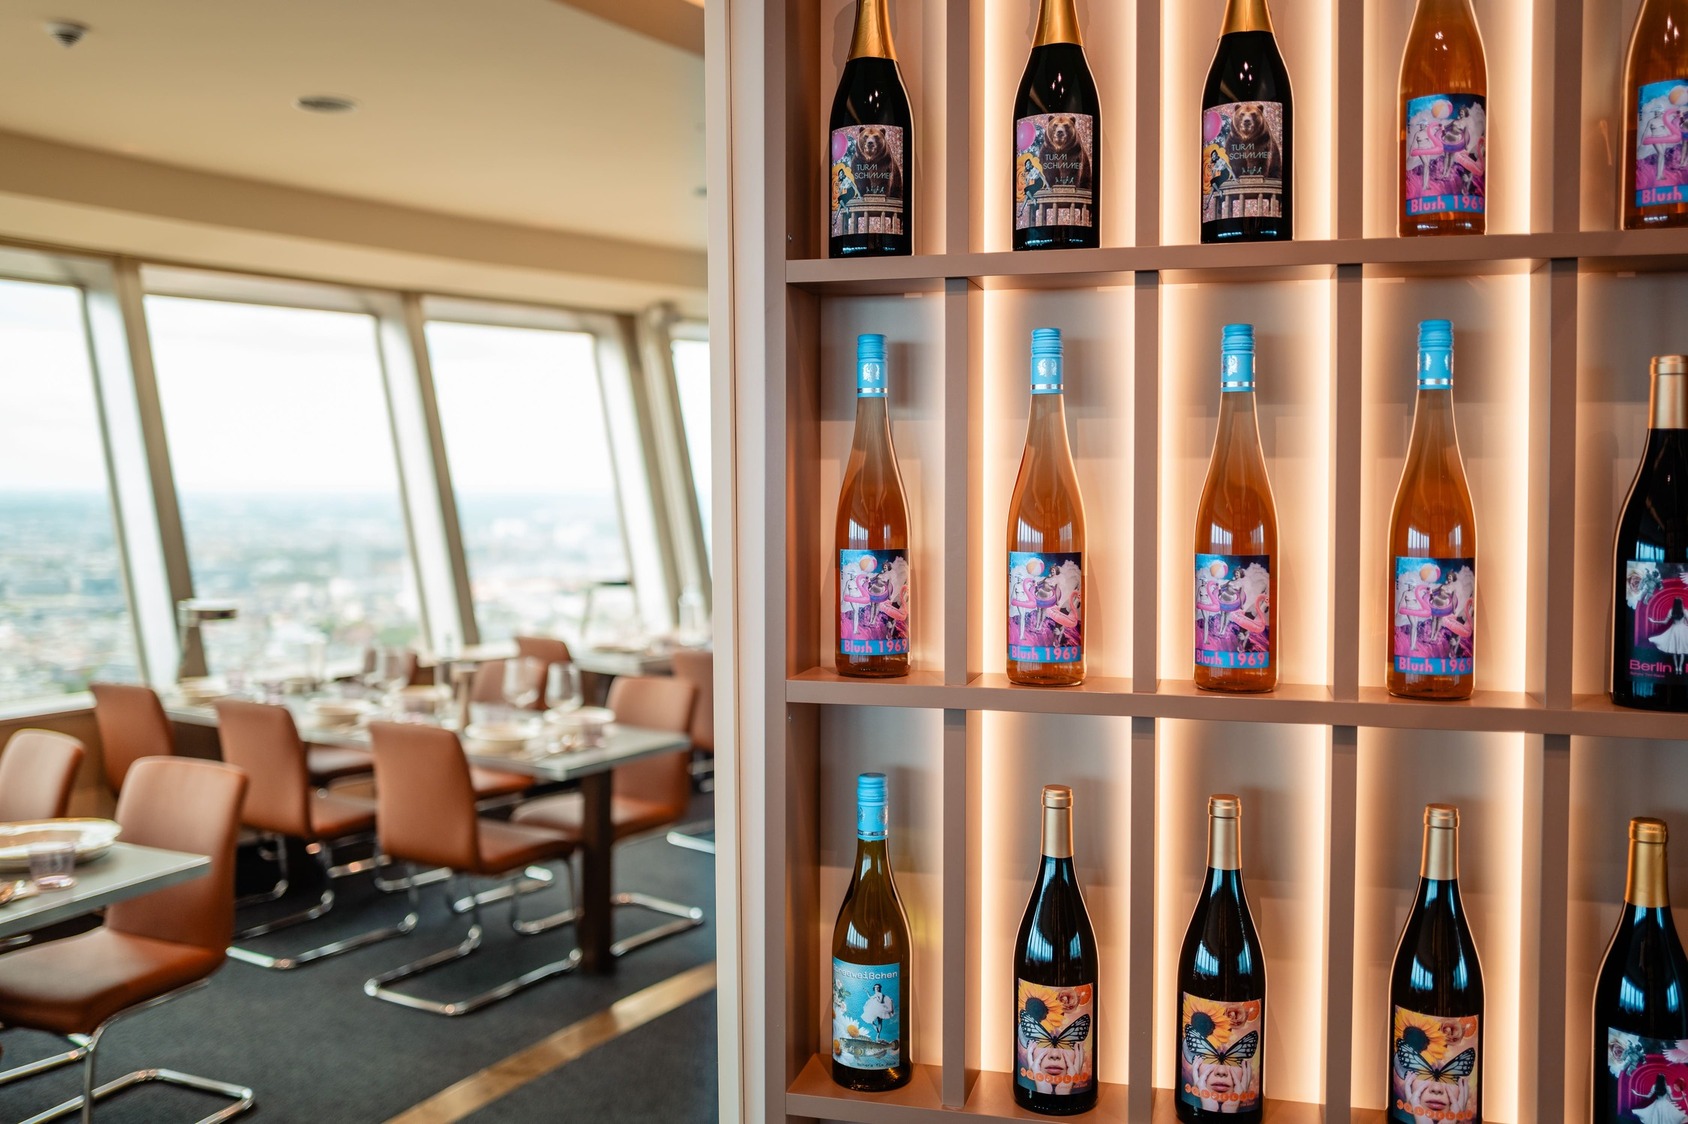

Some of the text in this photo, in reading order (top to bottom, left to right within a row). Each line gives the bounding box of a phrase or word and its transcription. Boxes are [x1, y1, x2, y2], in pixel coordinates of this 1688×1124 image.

[1231, 143, 1255, 151] TURM
[1045, 153, 1068, 161] TURM
[1229, 151, 1272, 160] SCHIMMER
[856, 163, 878, 171] TURM
[1642, 186, 1682, 204] Blush
[1410, 195, 1485, 213] Blush 1969
[844, 639, 908, 653] Blush 1969
[1011, 645, 1078, 660] Blush 1969
[1196, 649, 1265, 666] Blush 1969
[1399, 656, 1472, 672] Blush 1969
[1629, 659, 1672, 673] Berlin
